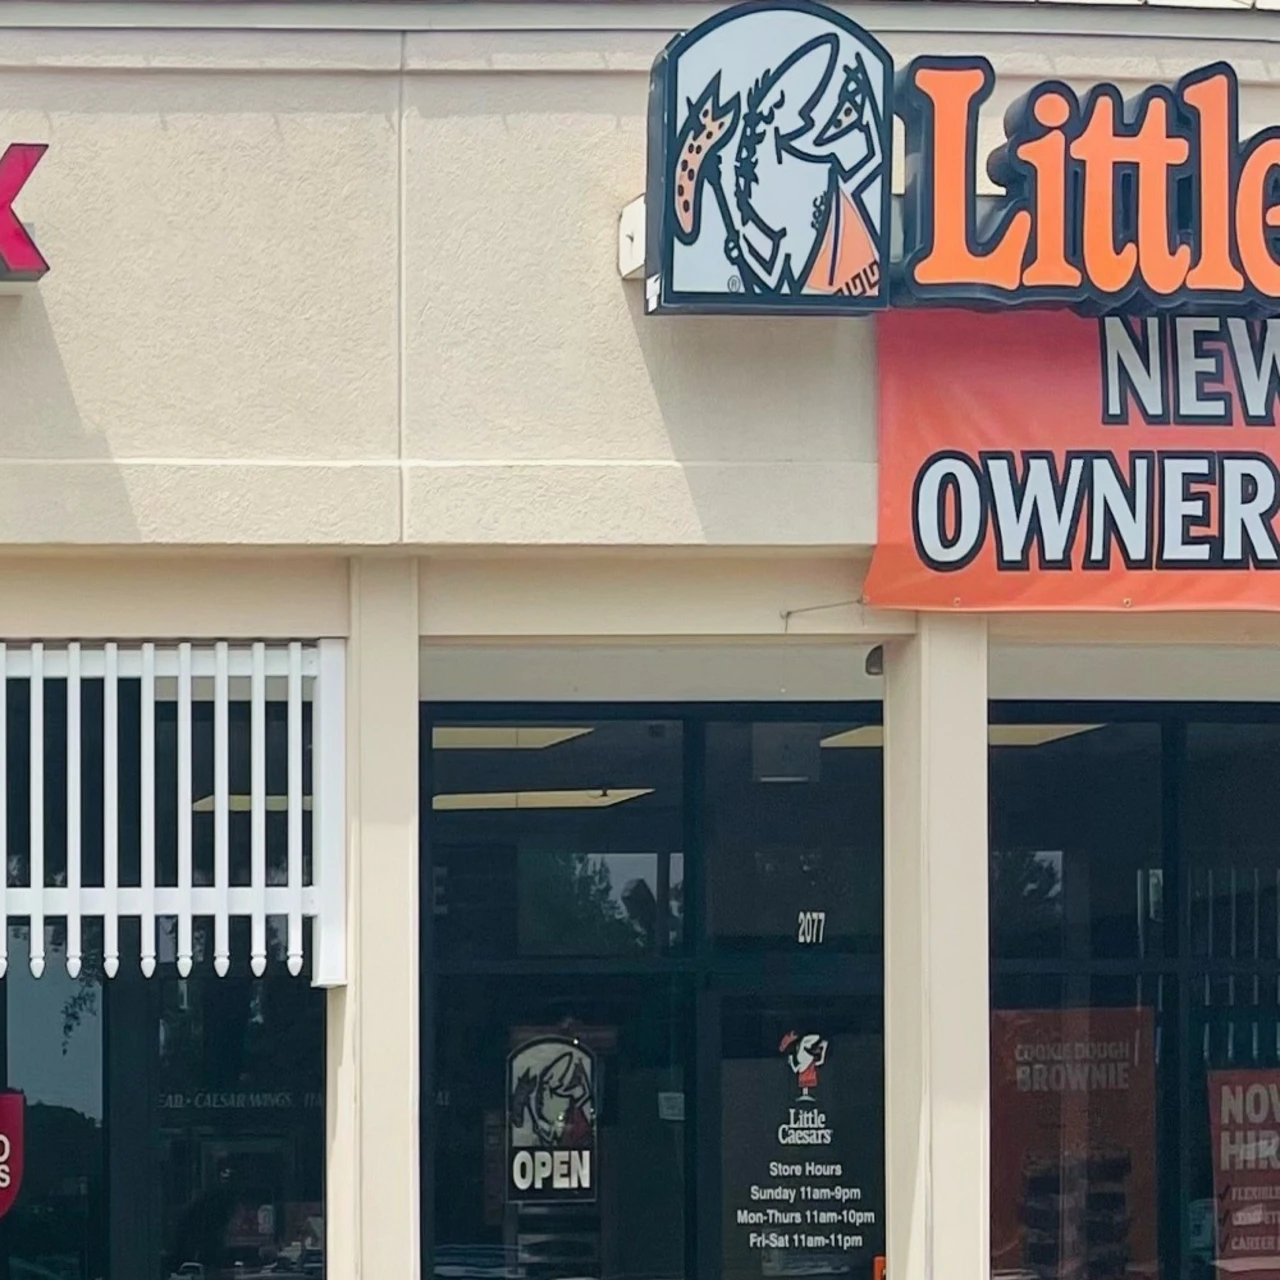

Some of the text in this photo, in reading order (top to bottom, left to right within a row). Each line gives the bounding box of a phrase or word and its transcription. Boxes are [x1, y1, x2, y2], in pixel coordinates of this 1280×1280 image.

[798, 911, 825, 944] 2077
[1016, 1061, 1130, 1092] BROWNIE
[788, 1108, 826, 1128] Little
[778, 1124, 833, 1144] Caesars
[512, 1150, 591, 1190] OPEN
[769, 1161, 842, 1176] Store Hours
[750, 1185, 861, 1203] Sunday 11am-9pm
[736, 1209, 875, 1226] Mon-Thurs 11am-10pm
[749, 1233, 863, 1250] Fri-Sat 11am-11pm
